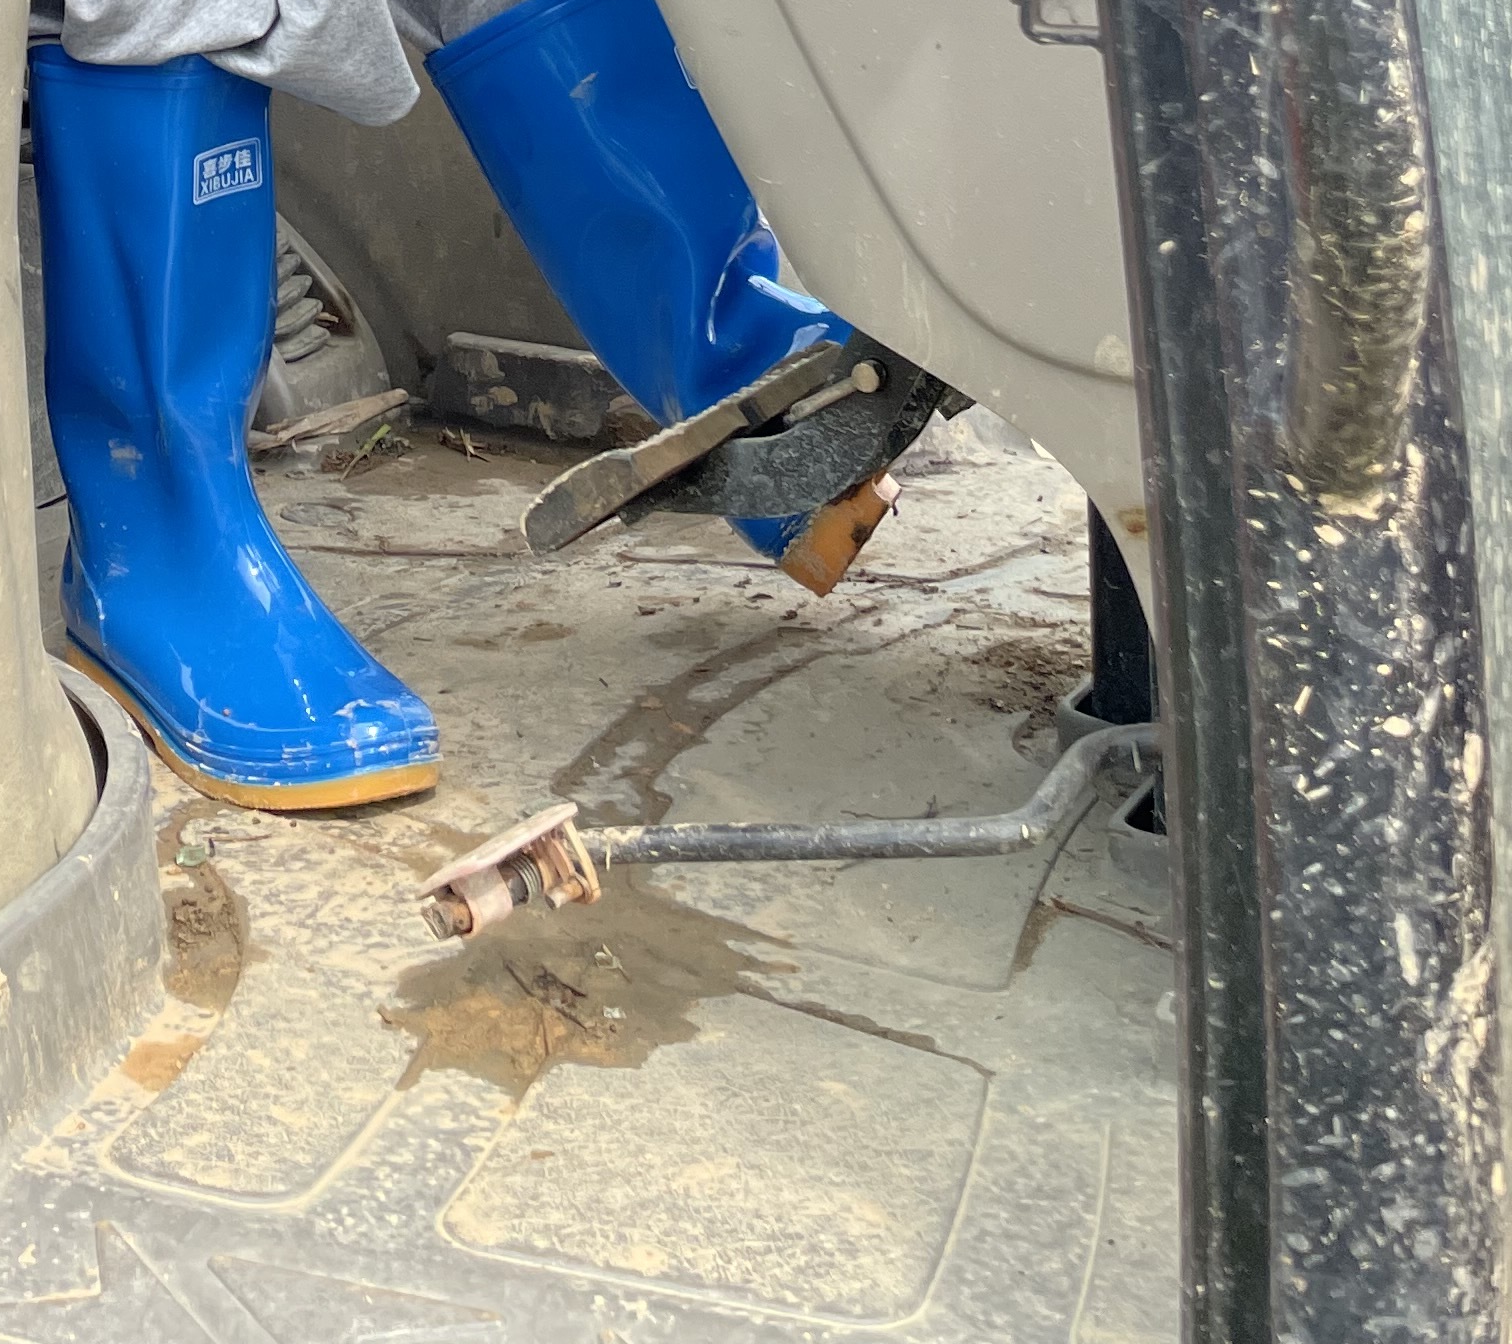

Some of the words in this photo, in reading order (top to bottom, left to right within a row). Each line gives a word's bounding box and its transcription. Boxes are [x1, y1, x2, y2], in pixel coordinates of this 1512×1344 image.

[202, 148, 251, 180] 喜步佳
[200, 168, 254, 196] XIBUJIA
